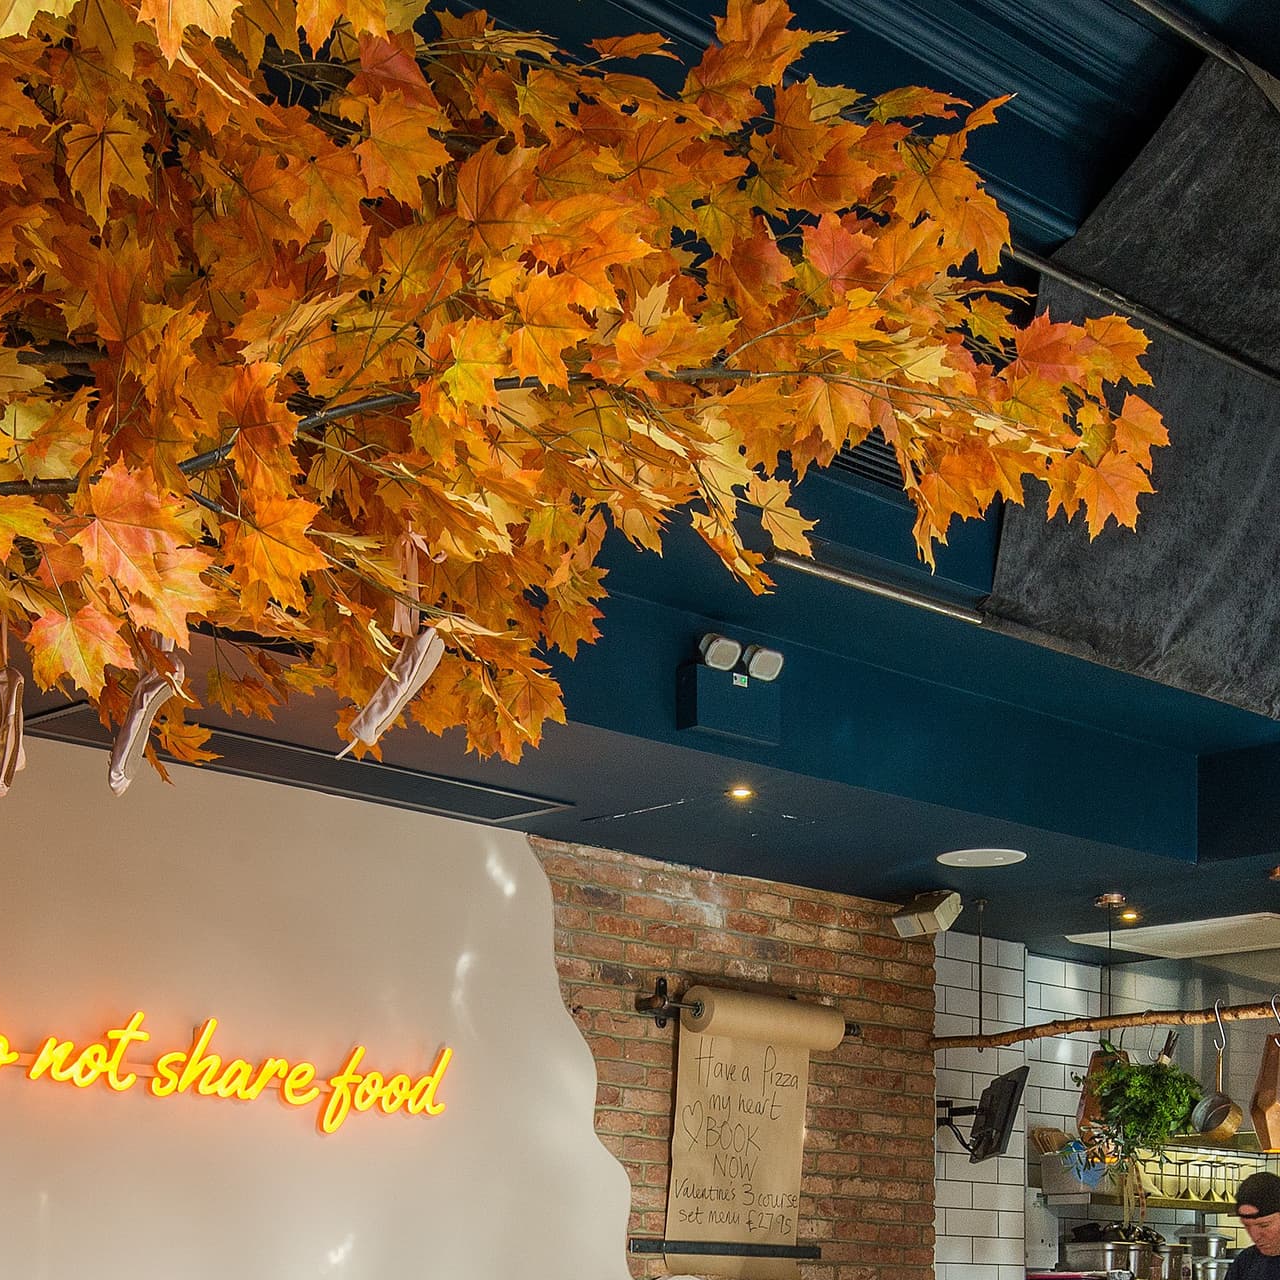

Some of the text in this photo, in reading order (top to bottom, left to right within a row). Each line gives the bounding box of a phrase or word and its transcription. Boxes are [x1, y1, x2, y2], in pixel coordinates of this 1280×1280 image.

[29, 1010, 151, 1092] not
[151, 1017, 320, 1106] share
[322, 1045, 453, 1134] food
[695, 1037, 799, 1097] Have a Pizza
[709, 1091, 783, 1121] my heart
[705, 1116, 762, 1156] BOOK
[712, 1153, 759, 1182] NOW
[675, 1178, 799, 1209] Valentine's 3 course
[679, 1206, 704, 1225] set
[708, 1210, 740, 1225] menu
